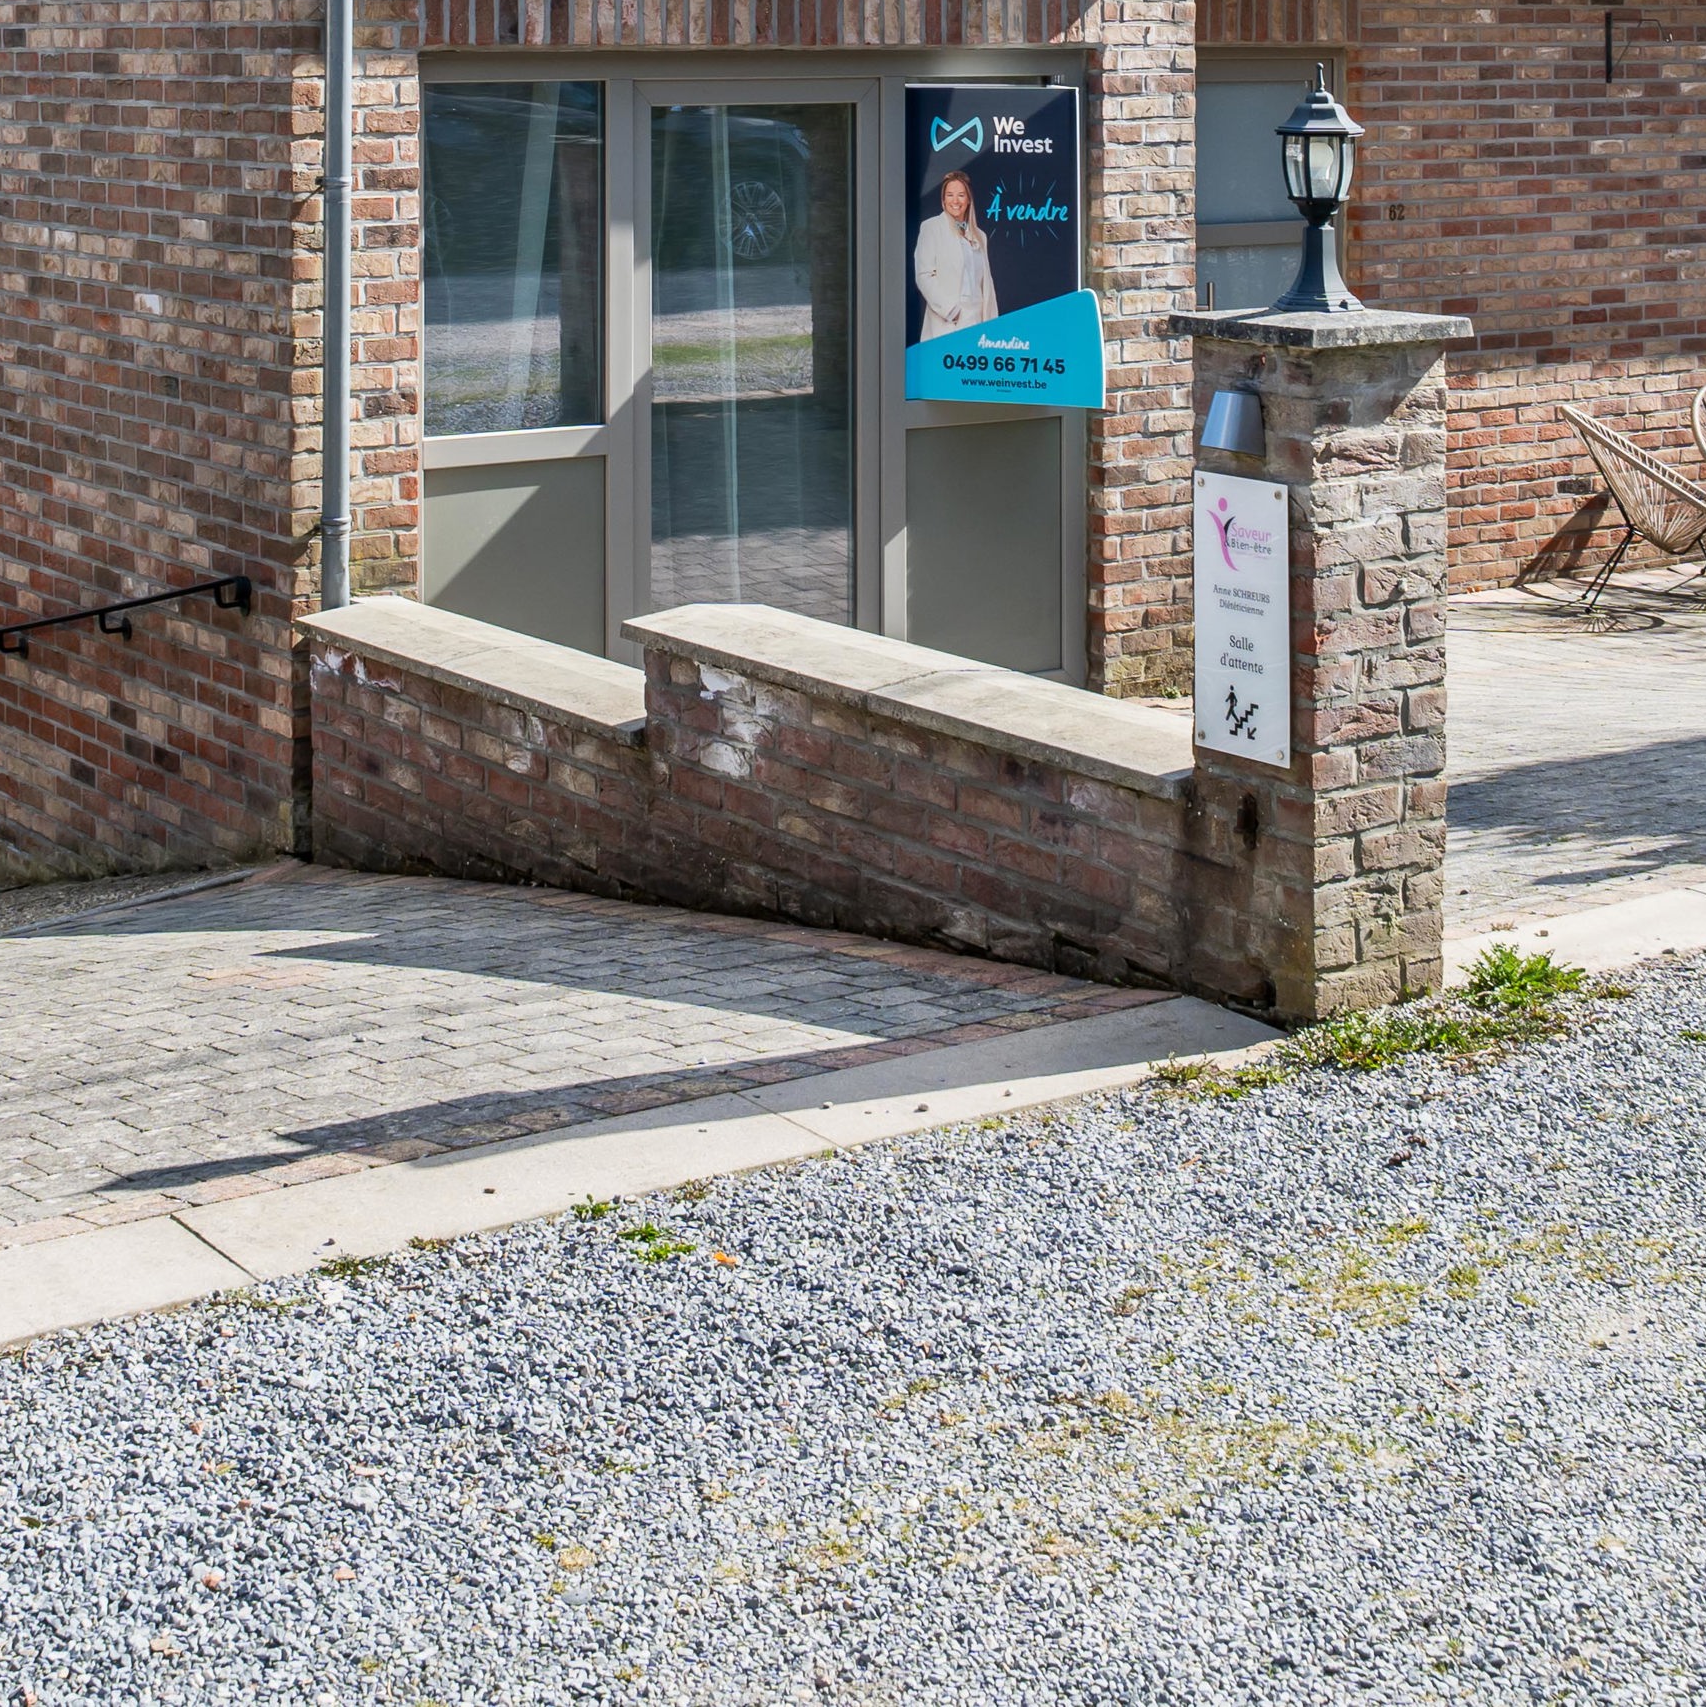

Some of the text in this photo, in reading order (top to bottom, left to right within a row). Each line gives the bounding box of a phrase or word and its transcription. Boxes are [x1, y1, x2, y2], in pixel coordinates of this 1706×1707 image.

[993, 116, 1025, 135] We
[994, 135, 1053, 153] Invest
[986, 186, 1069, 222] À vendre
[978, 334, 1030, 350] Amandine
[943, 354, 1065, 374] 0499 66 71 45
[961, 378, 1047, 389] www.weinvest.be
[1231, 523, 1272, 542] Saveur
[1213, 584, 1270, 604] Anne SCHREURS
[1219, 598, 1264, 616] Diététicienne
[1229, 635, 1254, 652] Salle
[1220, 653, 1264, 674] d'attente
